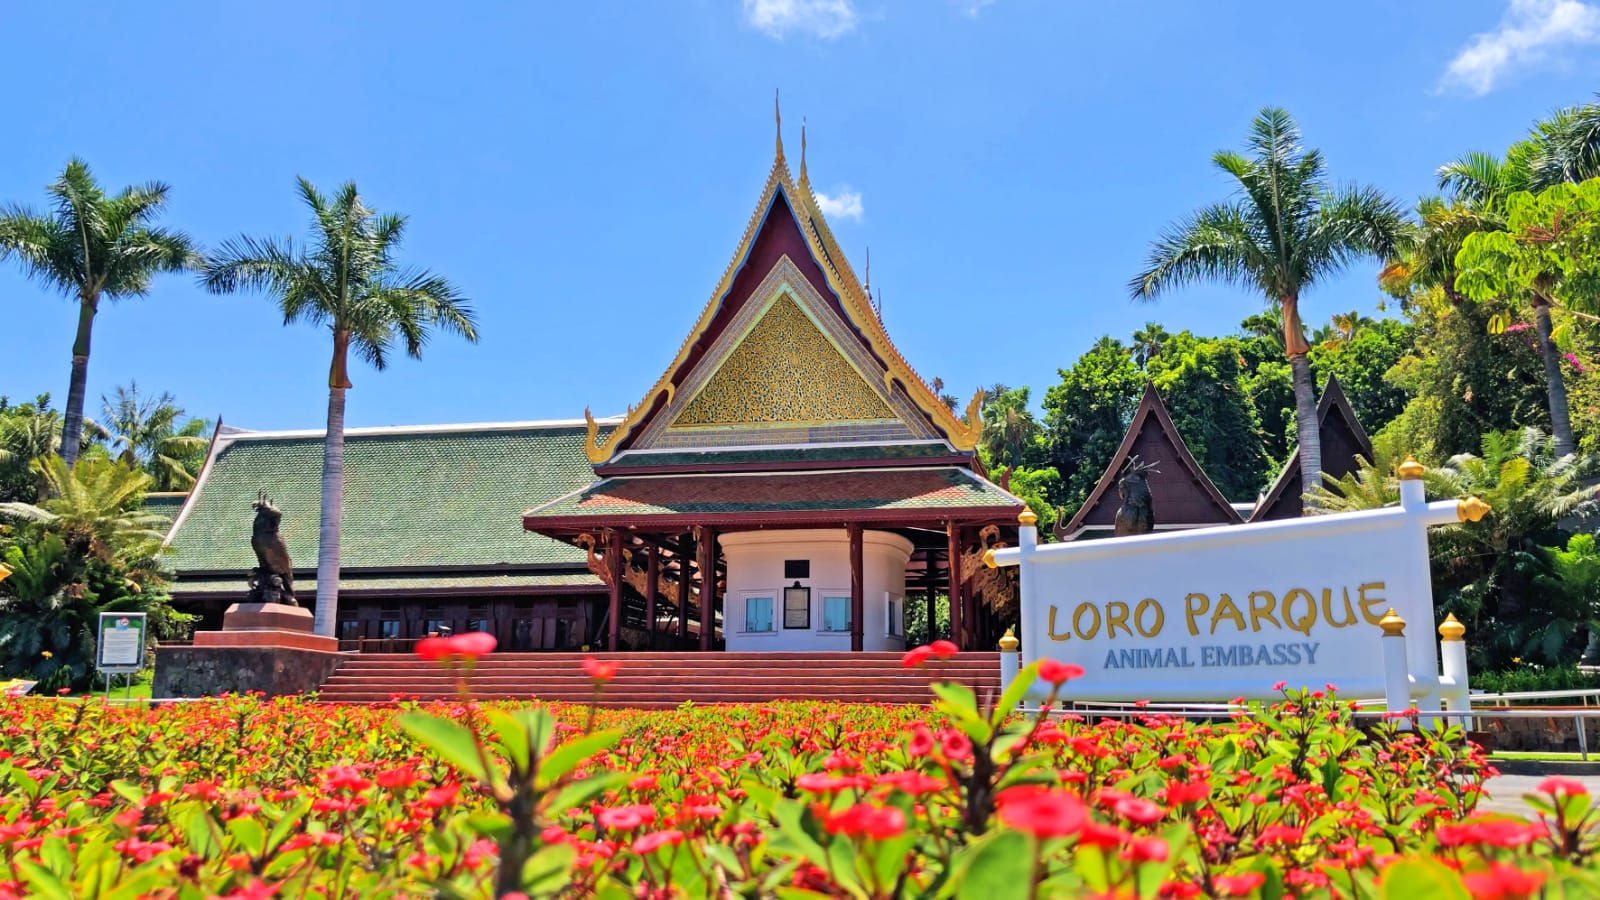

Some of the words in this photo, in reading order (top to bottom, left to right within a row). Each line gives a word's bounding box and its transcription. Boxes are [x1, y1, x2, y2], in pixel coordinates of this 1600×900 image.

[1048, 598, 1165, 642] LORO
[1185, 582, 1387, 637] PARQUE
[1103, 646, 1195, 670] ANIMAL
[1200, 642, 1320, 667] EMBASSY
